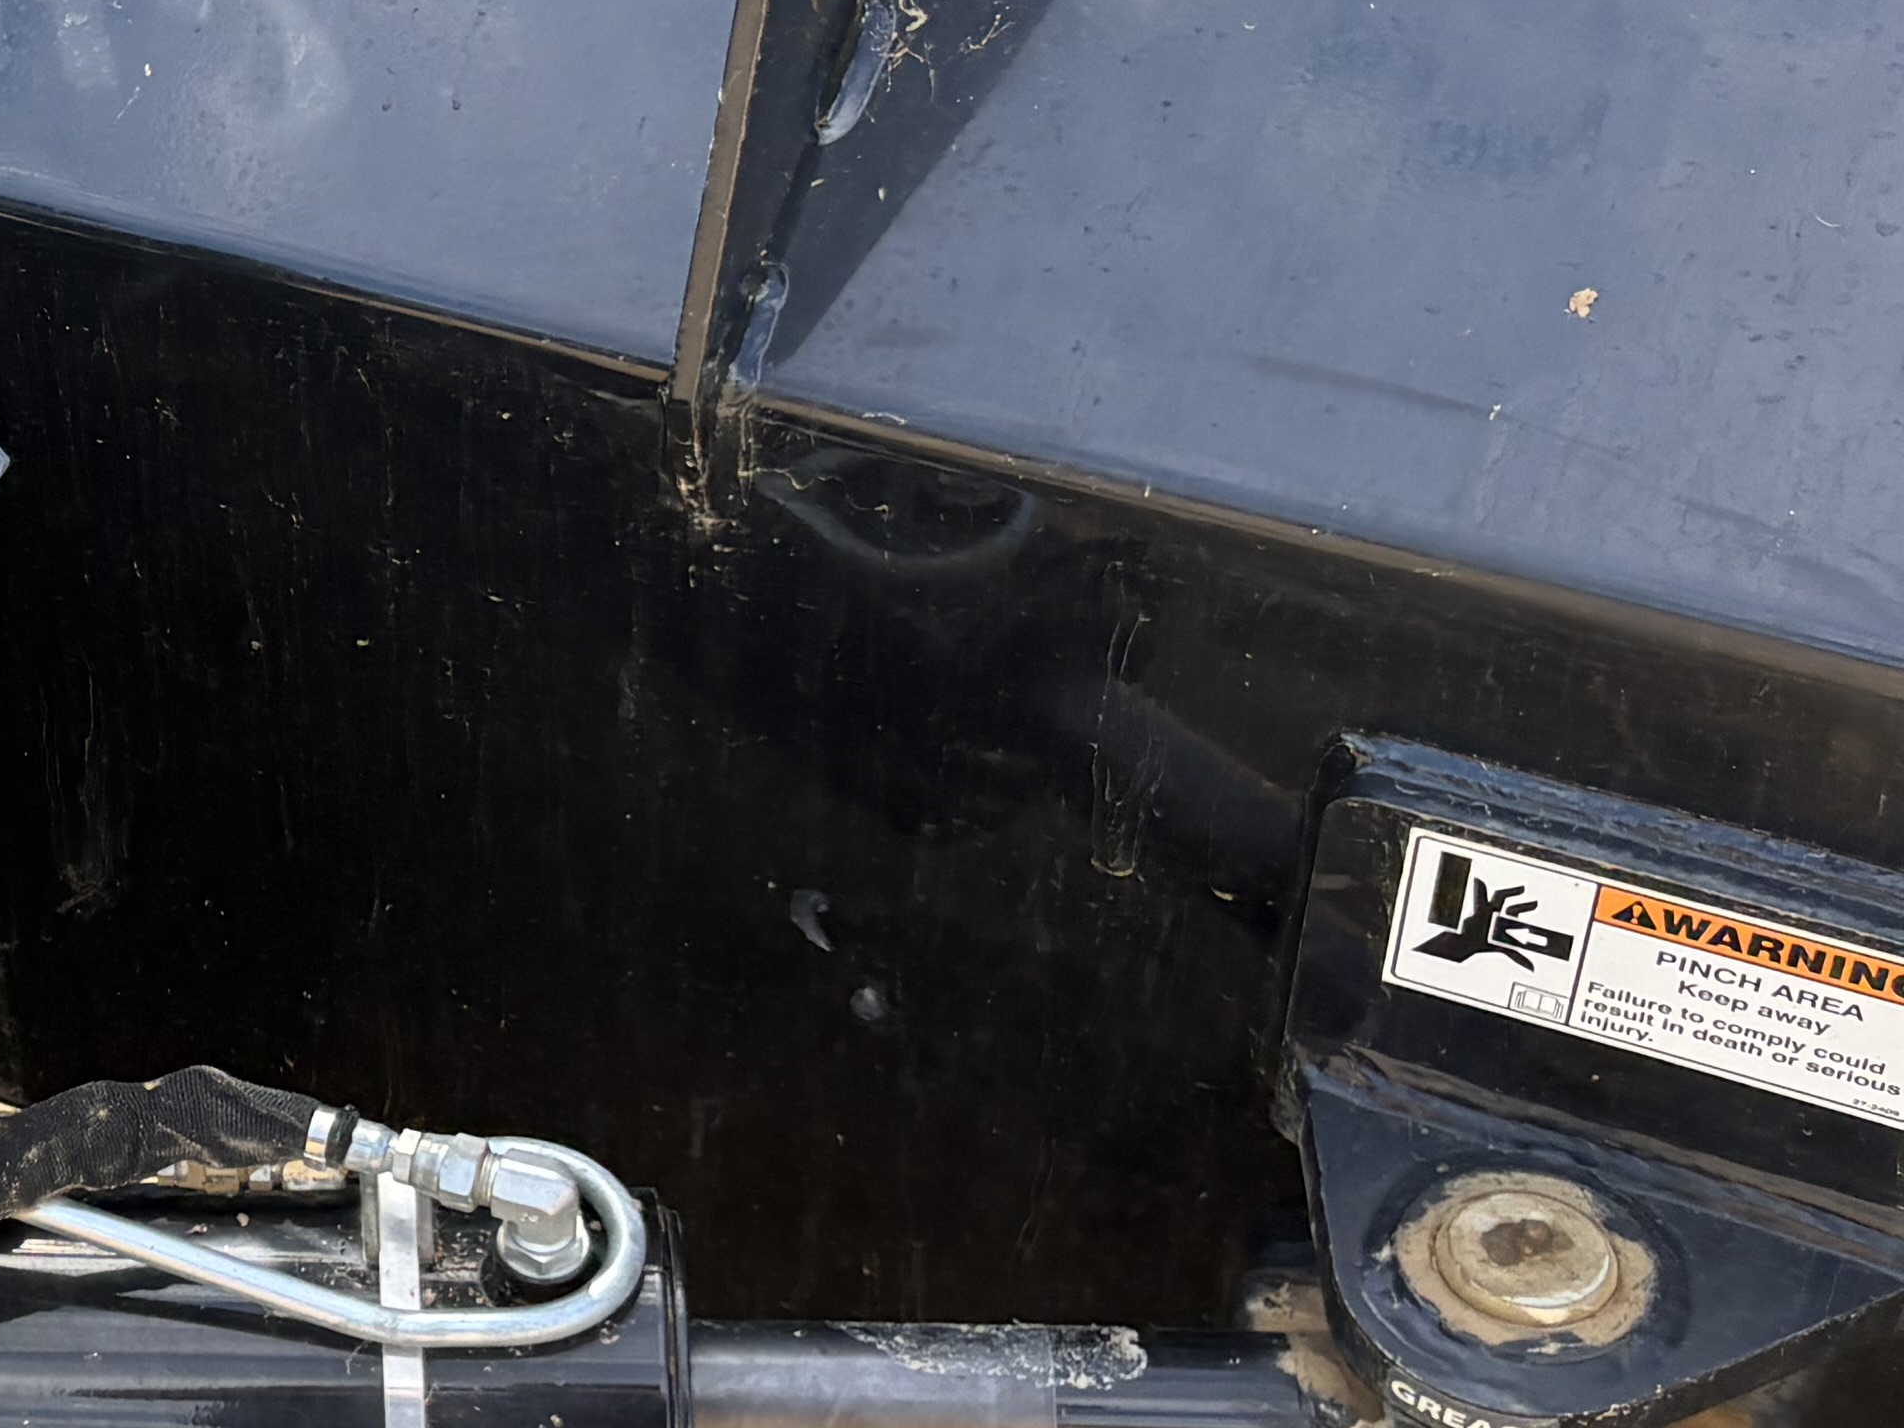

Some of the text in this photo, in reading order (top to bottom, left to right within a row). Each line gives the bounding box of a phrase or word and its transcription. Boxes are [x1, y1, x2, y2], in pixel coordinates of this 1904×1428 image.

[1656, 950, 1864, 1022] PINCH AREA
[1678, 980, 1832, 1035] Keep away
[1580, 1011, 1654, 1043] injury.
[1584, 997, 1901, 1096] result in death or serious
[1588, 981, 1886, 1076] Failure to comply could
